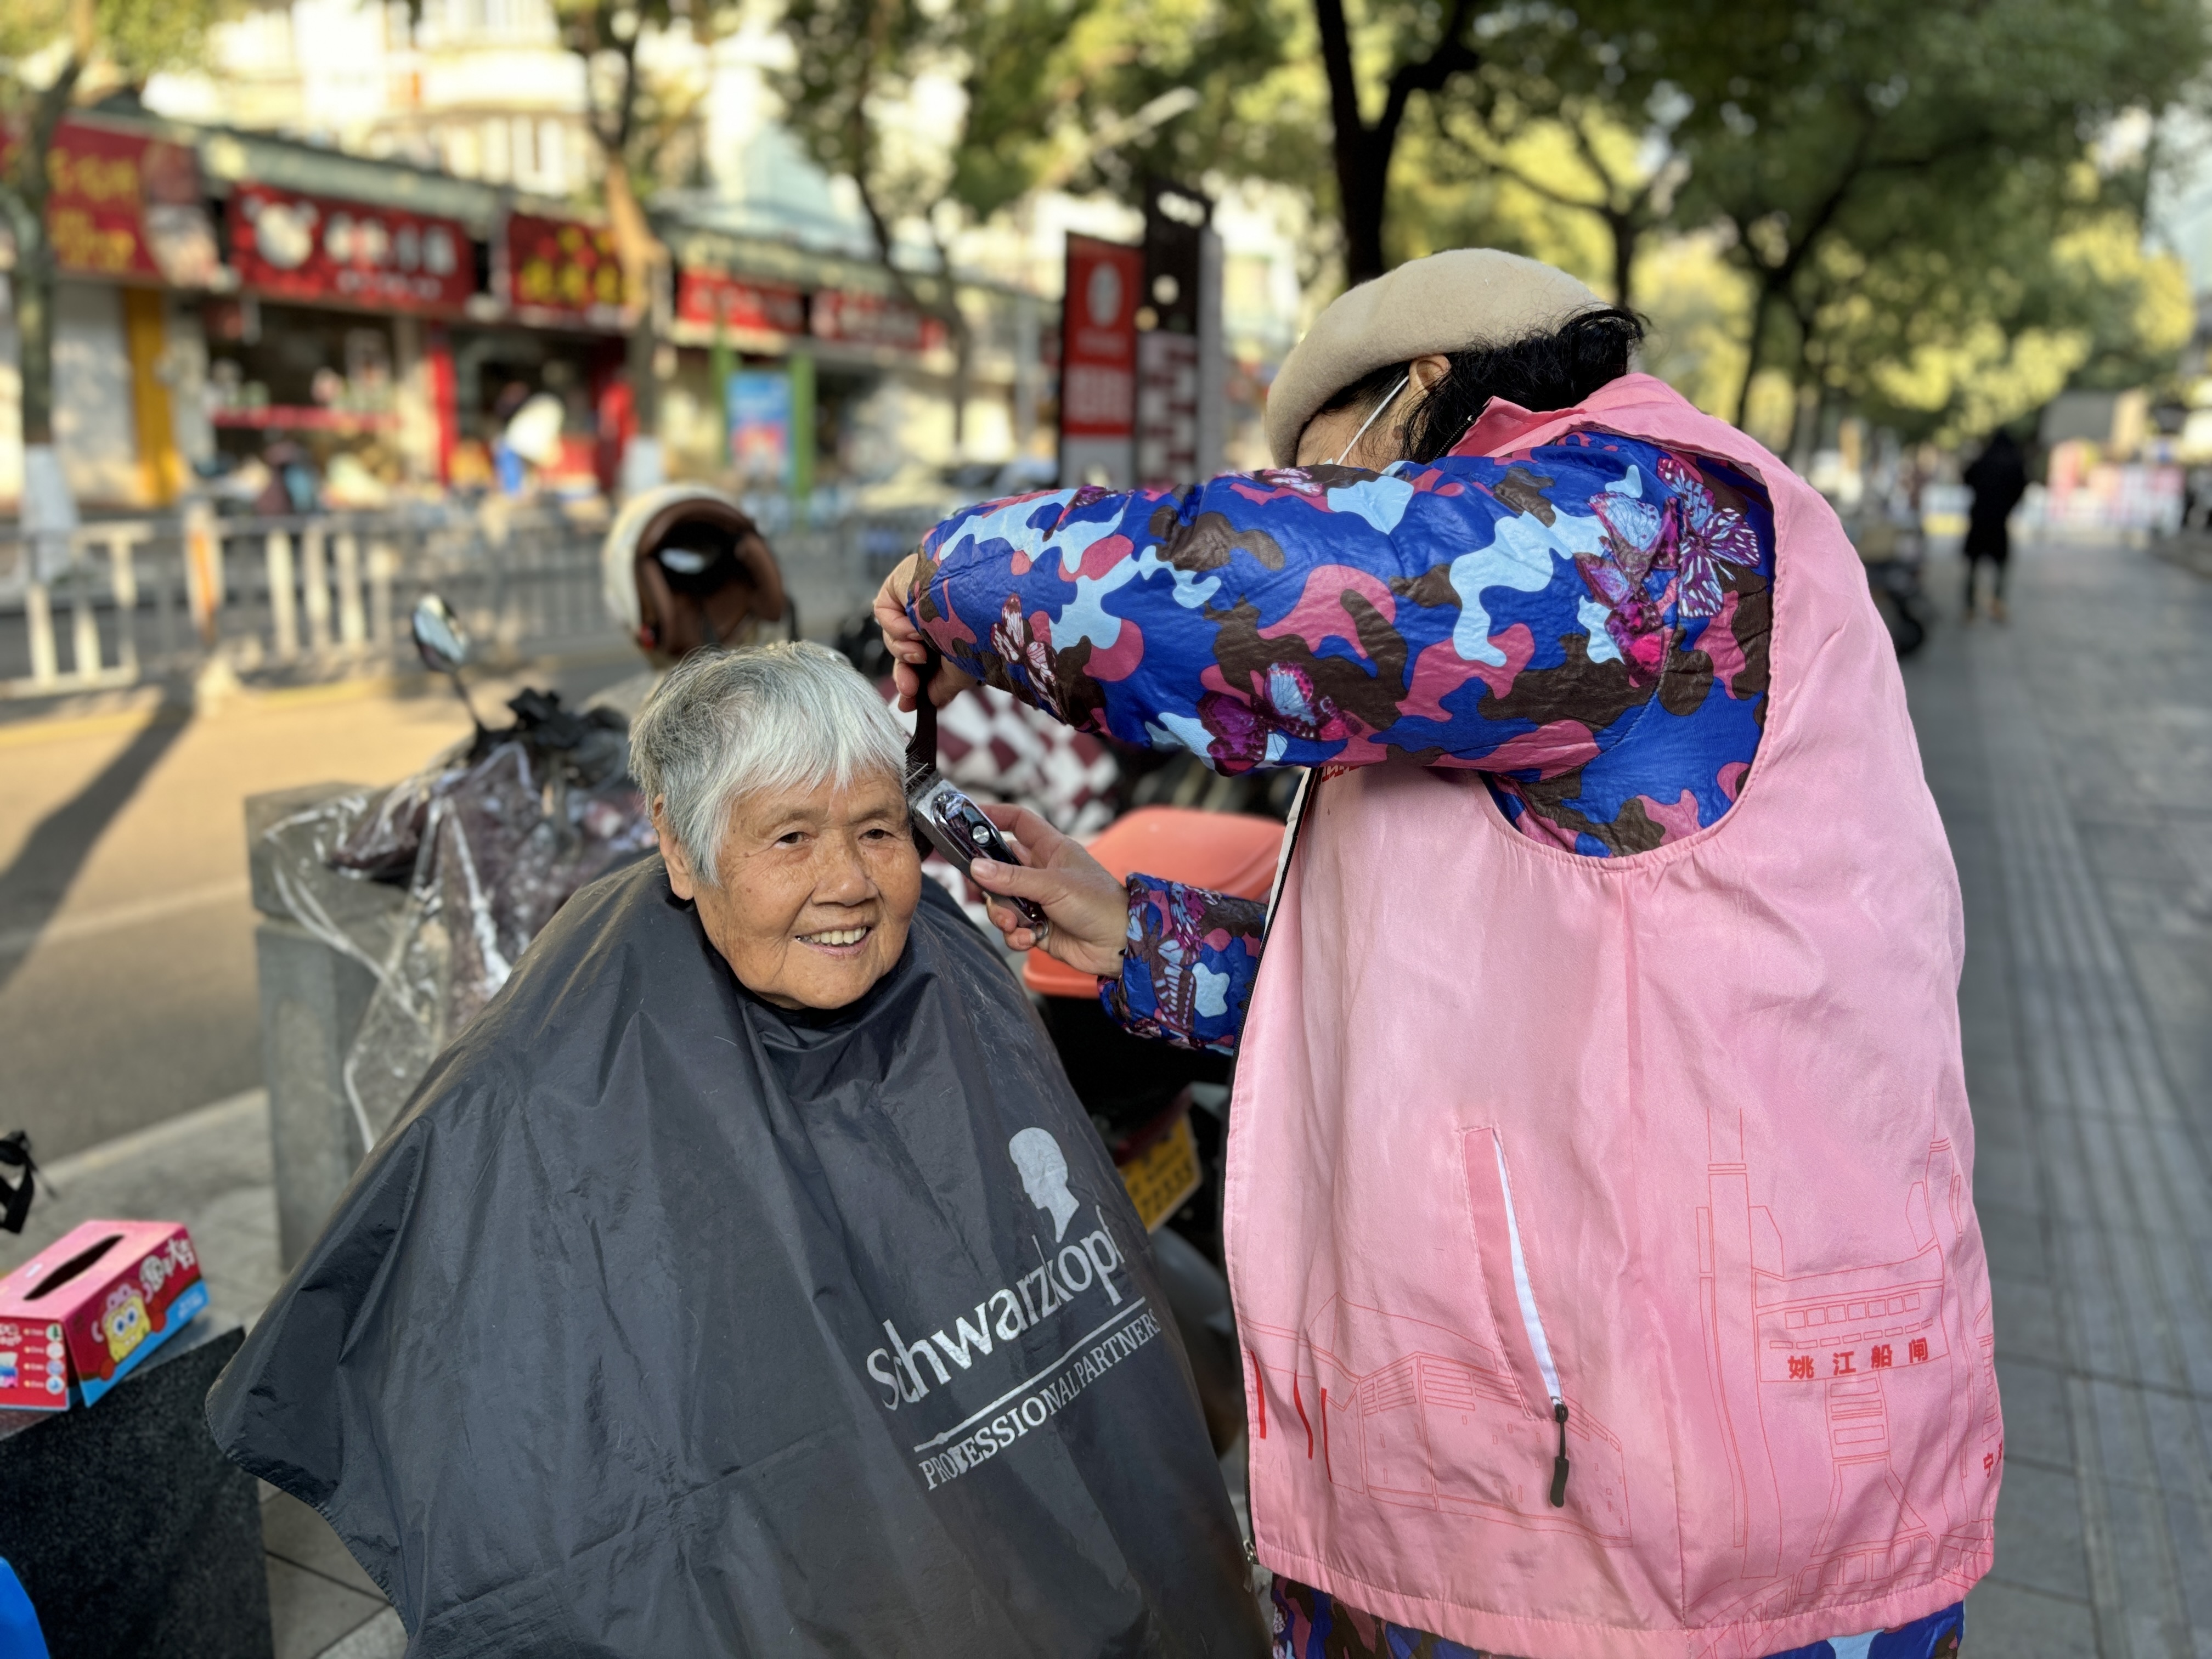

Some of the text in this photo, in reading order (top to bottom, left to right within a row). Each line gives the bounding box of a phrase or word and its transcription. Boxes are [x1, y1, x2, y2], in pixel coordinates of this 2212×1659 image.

[918, 1308, 1161, 1491] PROFESSIONAL PARTNERS
[1787, 1338, 1928, 1379] 姚江船闸
